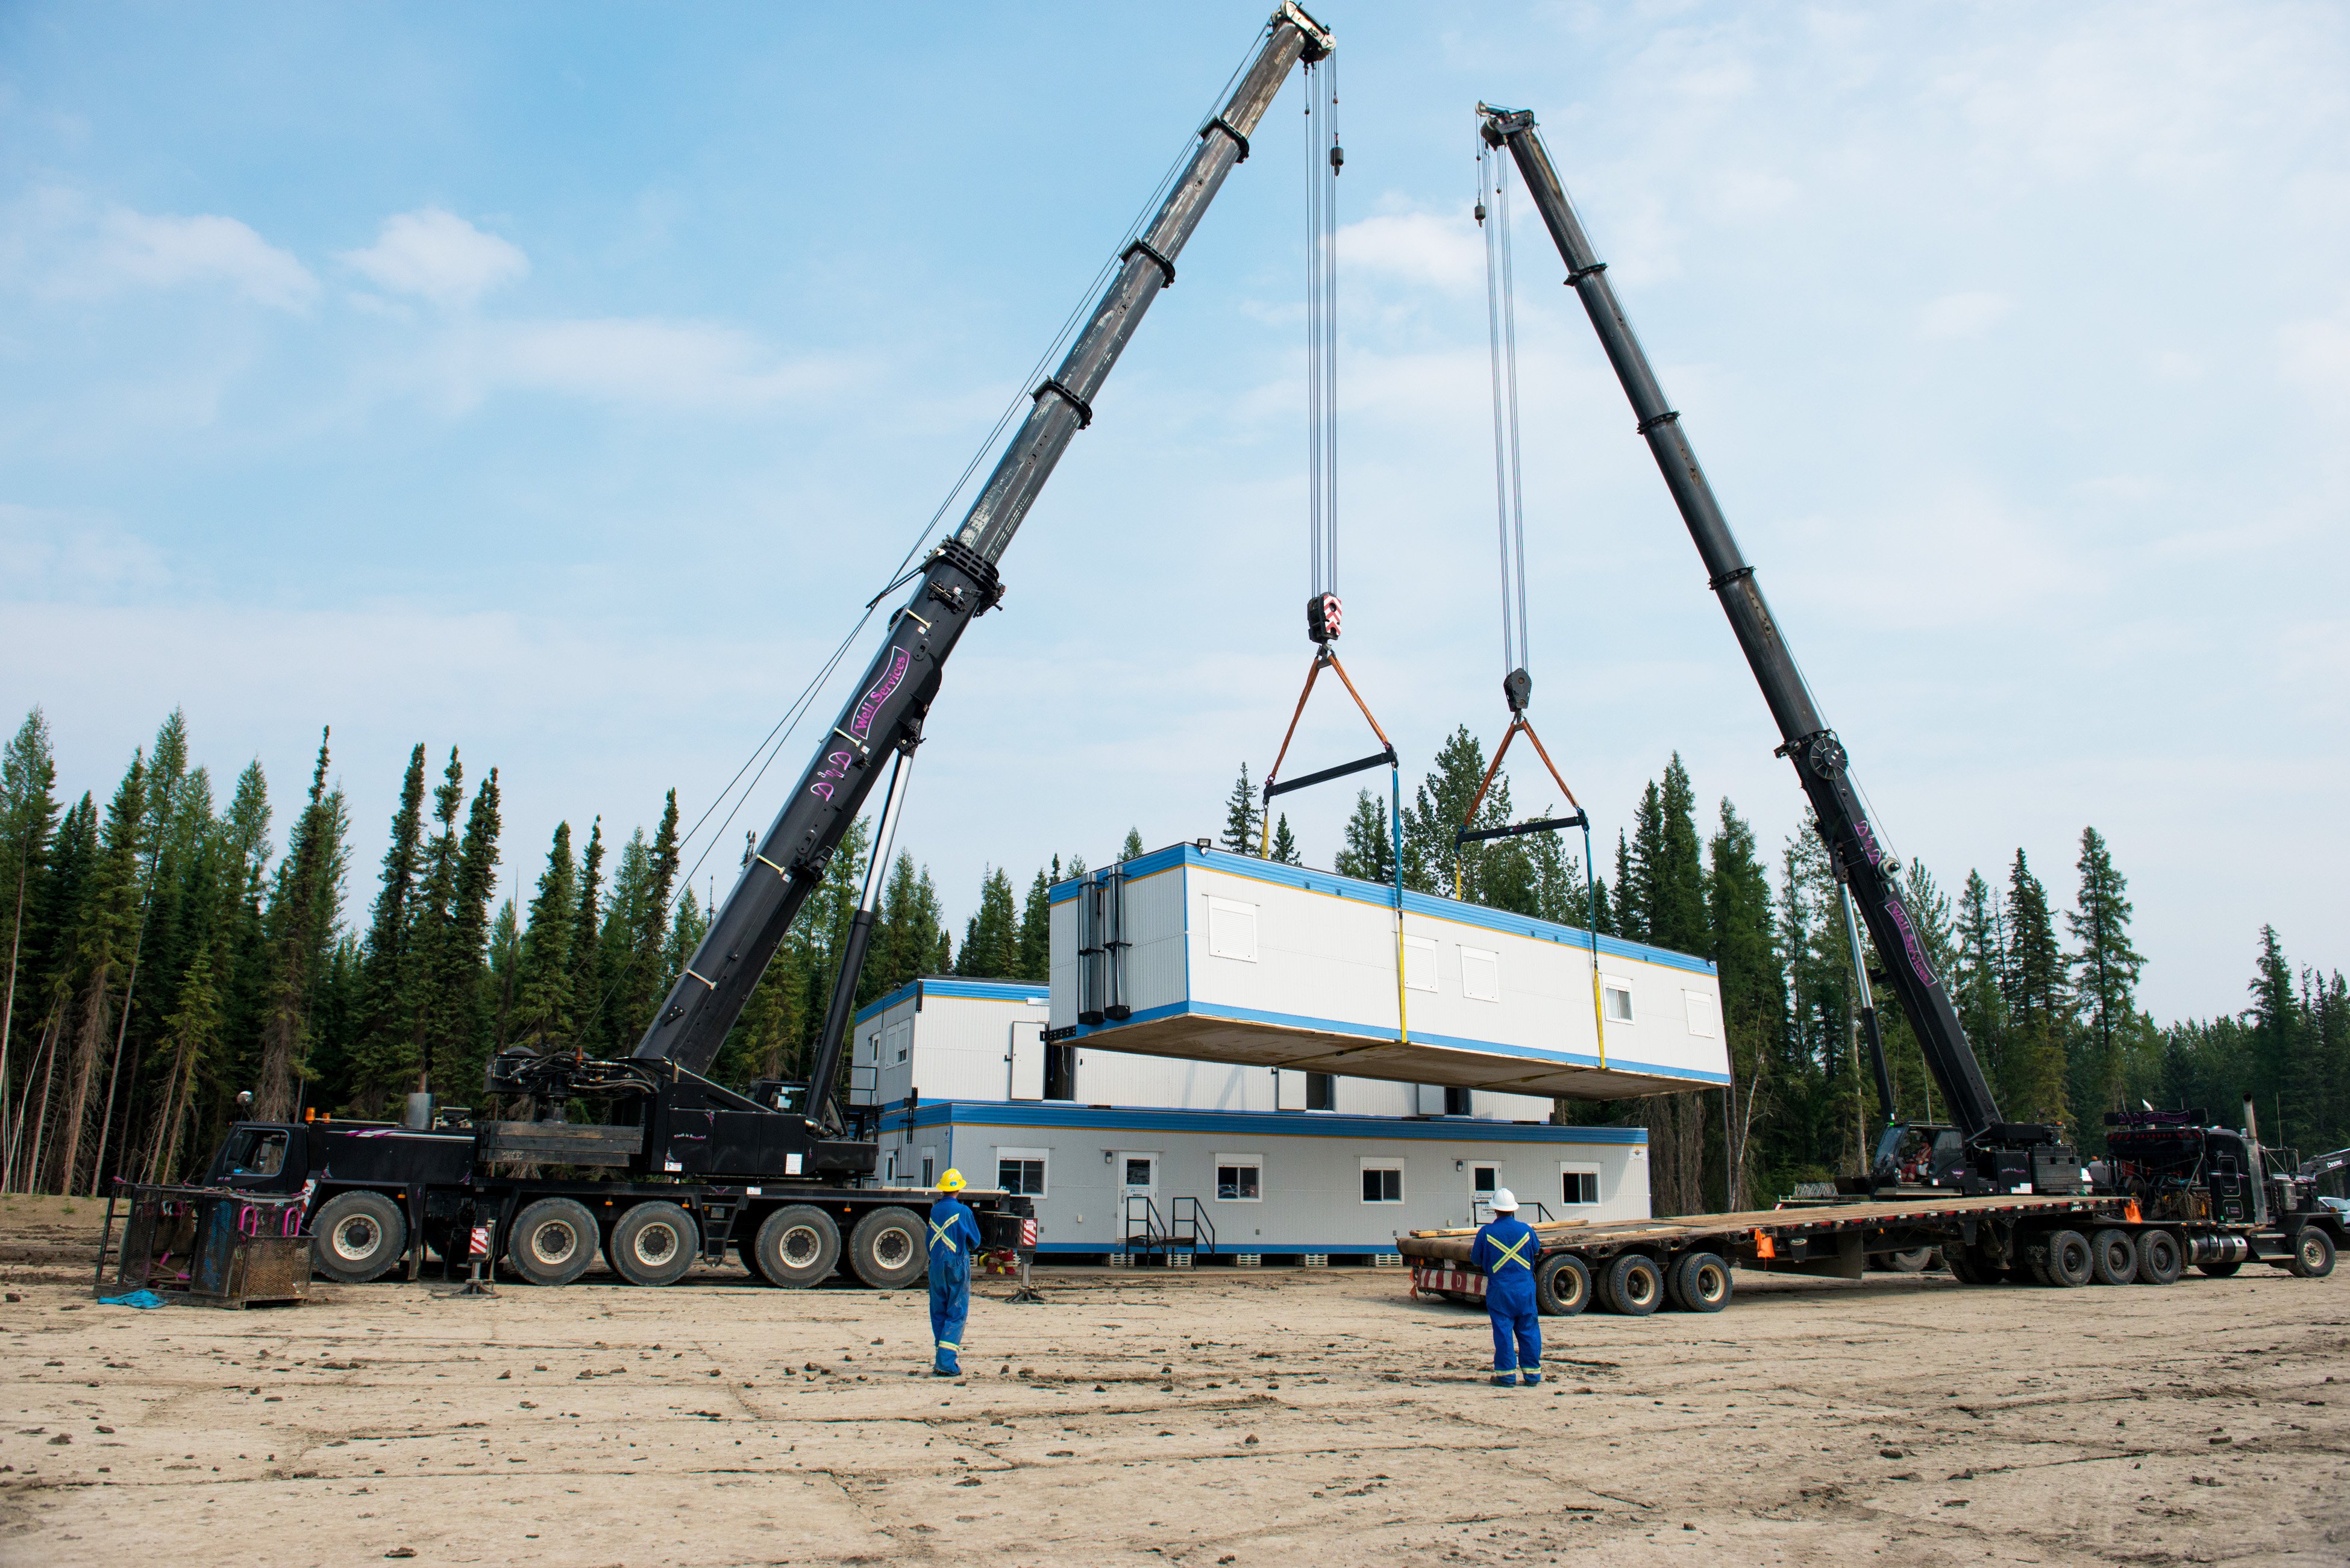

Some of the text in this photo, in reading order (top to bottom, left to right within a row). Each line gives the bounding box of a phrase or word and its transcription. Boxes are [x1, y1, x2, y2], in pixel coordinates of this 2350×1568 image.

[855, 657, 906, 729] Well Services
[810, 782, 834, 802] D
[829, 752, 852, 770] D
[1854, 820, 1869, 837] D
[1867, 849, 1881, 865] D
[1893, 906, 1929, 981] Well Services
[2326, 1160, 2343, 1169] DEERE
[1456, 1274, 1462, 1288] D
